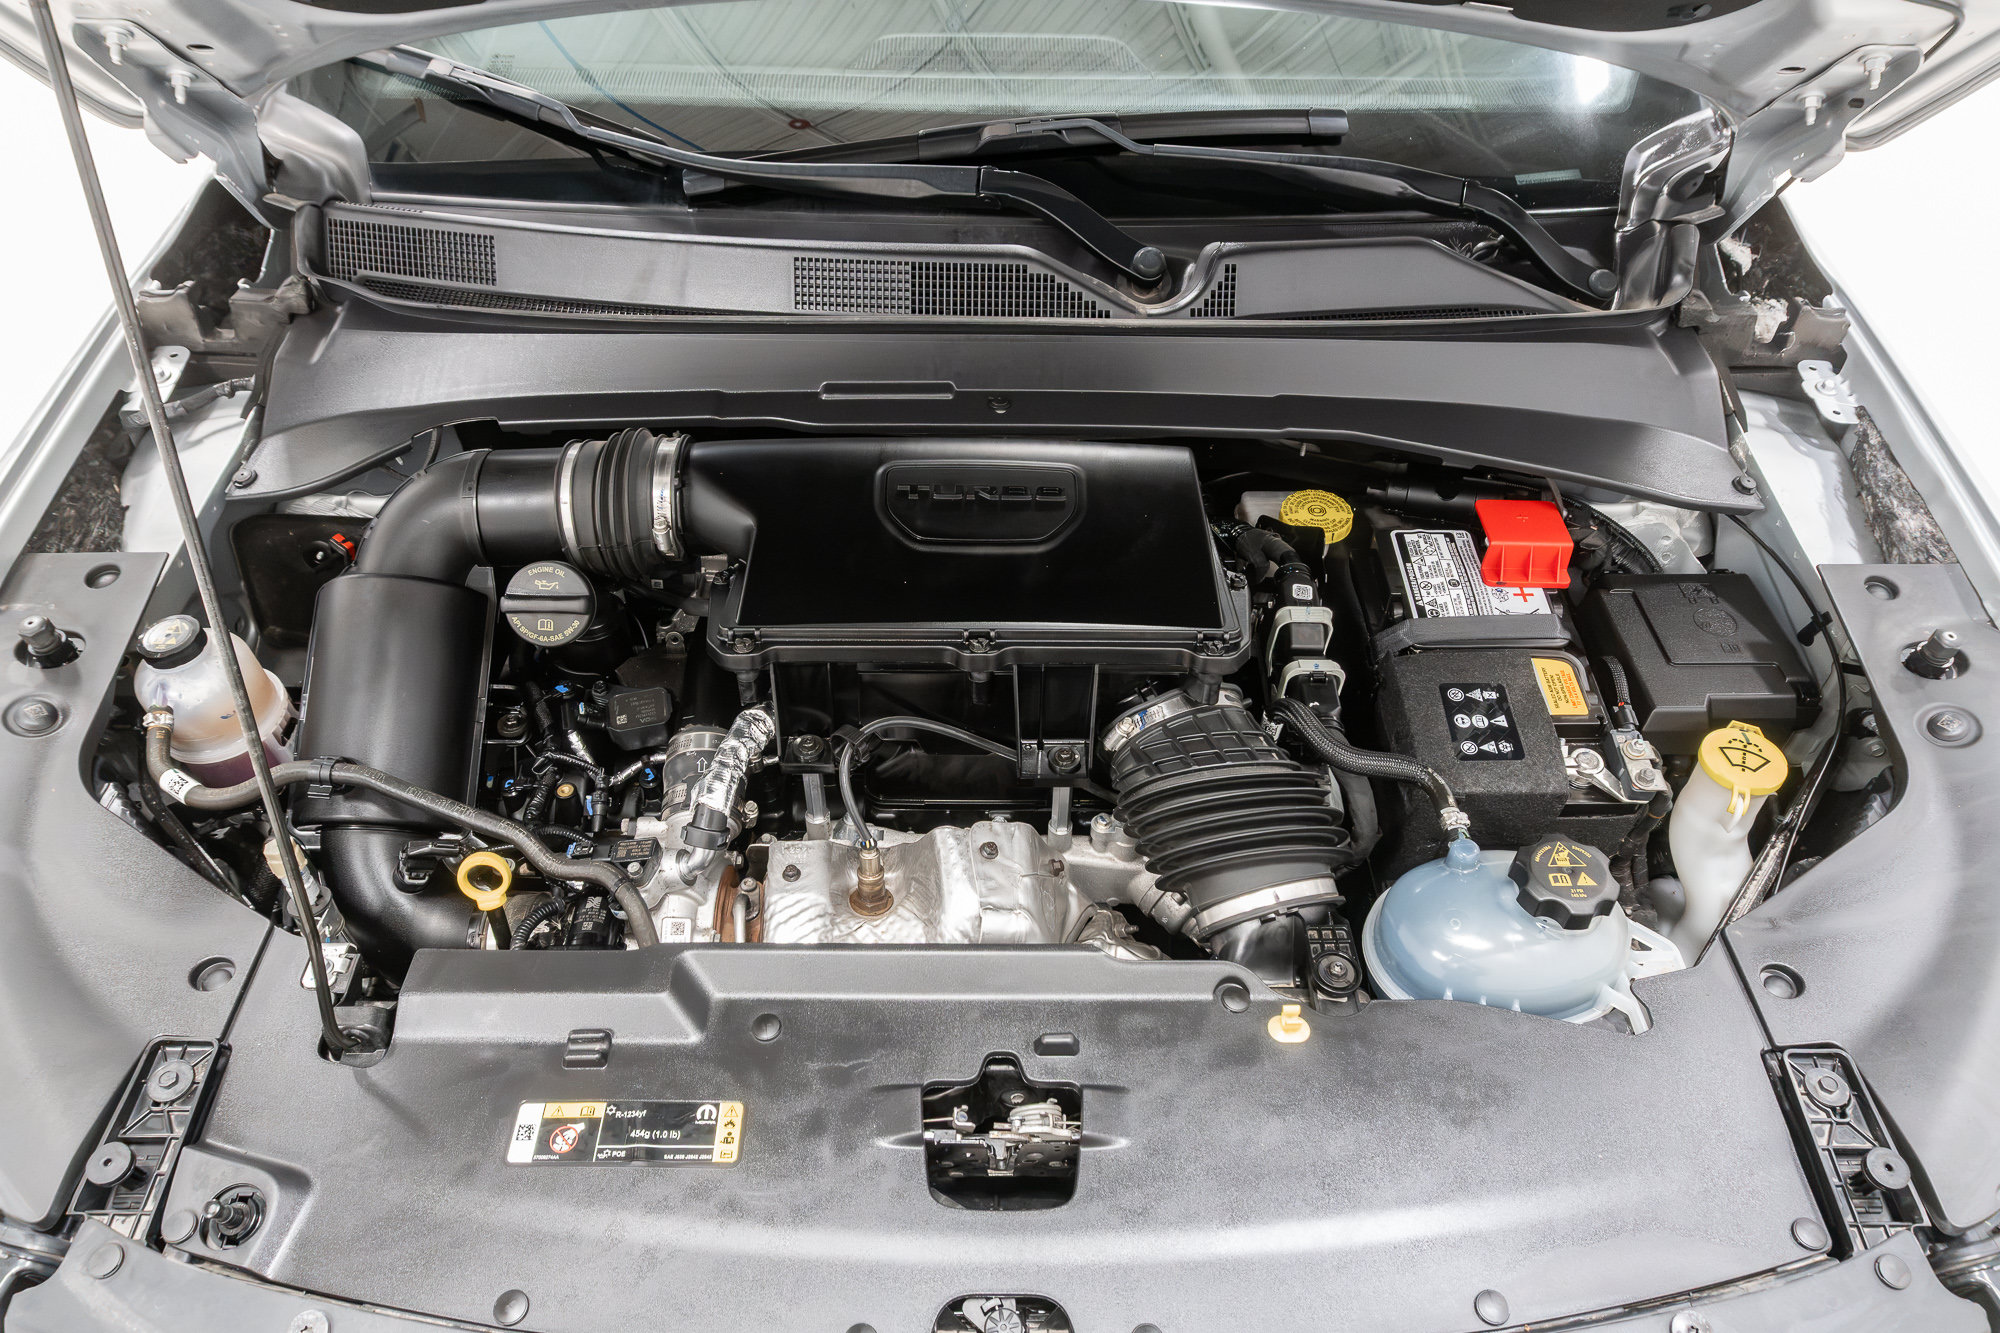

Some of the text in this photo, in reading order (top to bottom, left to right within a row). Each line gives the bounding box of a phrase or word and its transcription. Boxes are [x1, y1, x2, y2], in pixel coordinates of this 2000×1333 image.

[527, 566, 566, 578] ENGINE OIL
[511, 616, 521, 628] API
[563, 619, 580, 637] 5W-30
[615, 1109, 647, 1119] R-1234yf
[629, 1129, 681, 1140] 454g (1.0 lb)
[611, 1150, 626, 1158] POE
